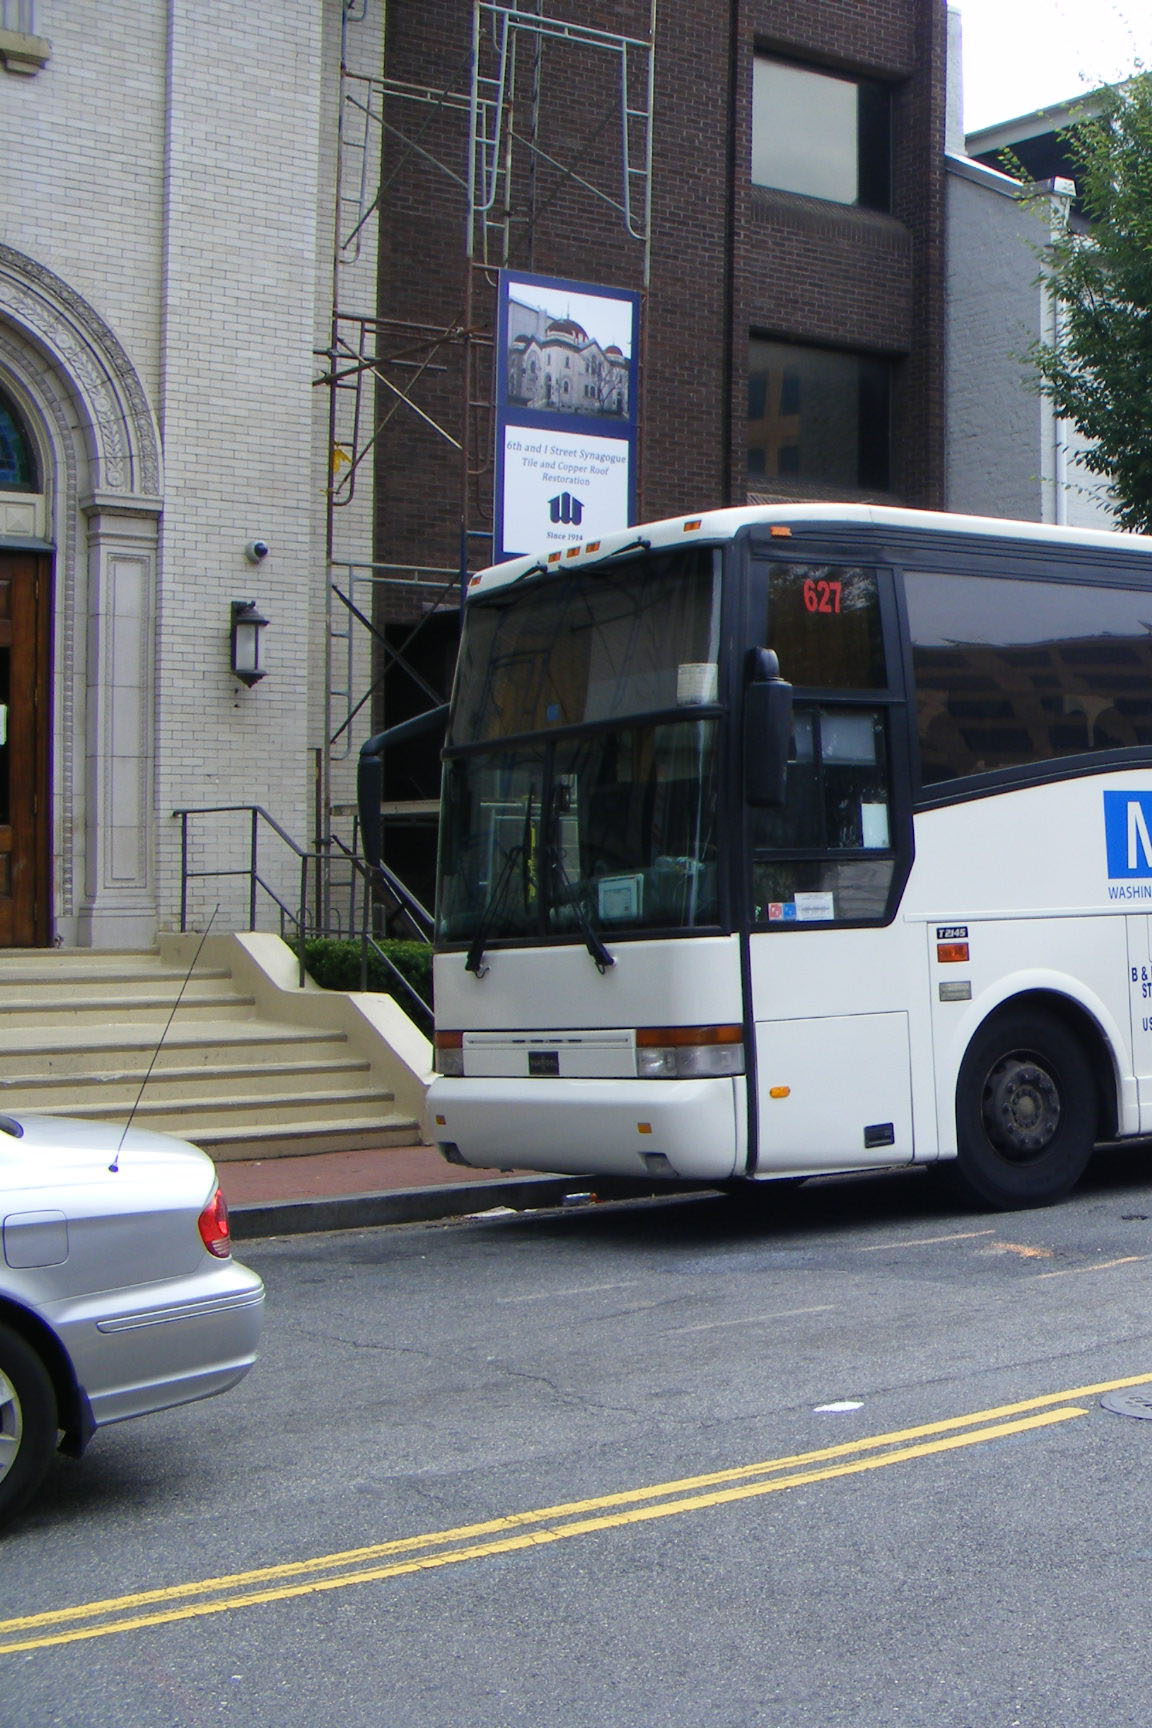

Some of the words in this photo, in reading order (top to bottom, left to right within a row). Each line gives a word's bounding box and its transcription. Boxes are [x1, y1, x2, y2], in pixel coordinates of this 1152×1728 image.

[506, 440, 522, 451] 6th
[524, 443, 541, 453] and
[550, 446, 577, 458] Street
[580, 449, 626, 464] Synagogue
[522, 457, 538, 468] Tile
[540, 460, 556, 469] and
[558, 461, 587, 474] Copper
[590, 465, 609, 475] Roof
[542, 472, 590, 486] Restoration
[546, 531, 566, 540] Since
[803, 578, 843, 613] 627
[1131, 967, 1138, 982] B
[1141, 966, 1148, 981] &
